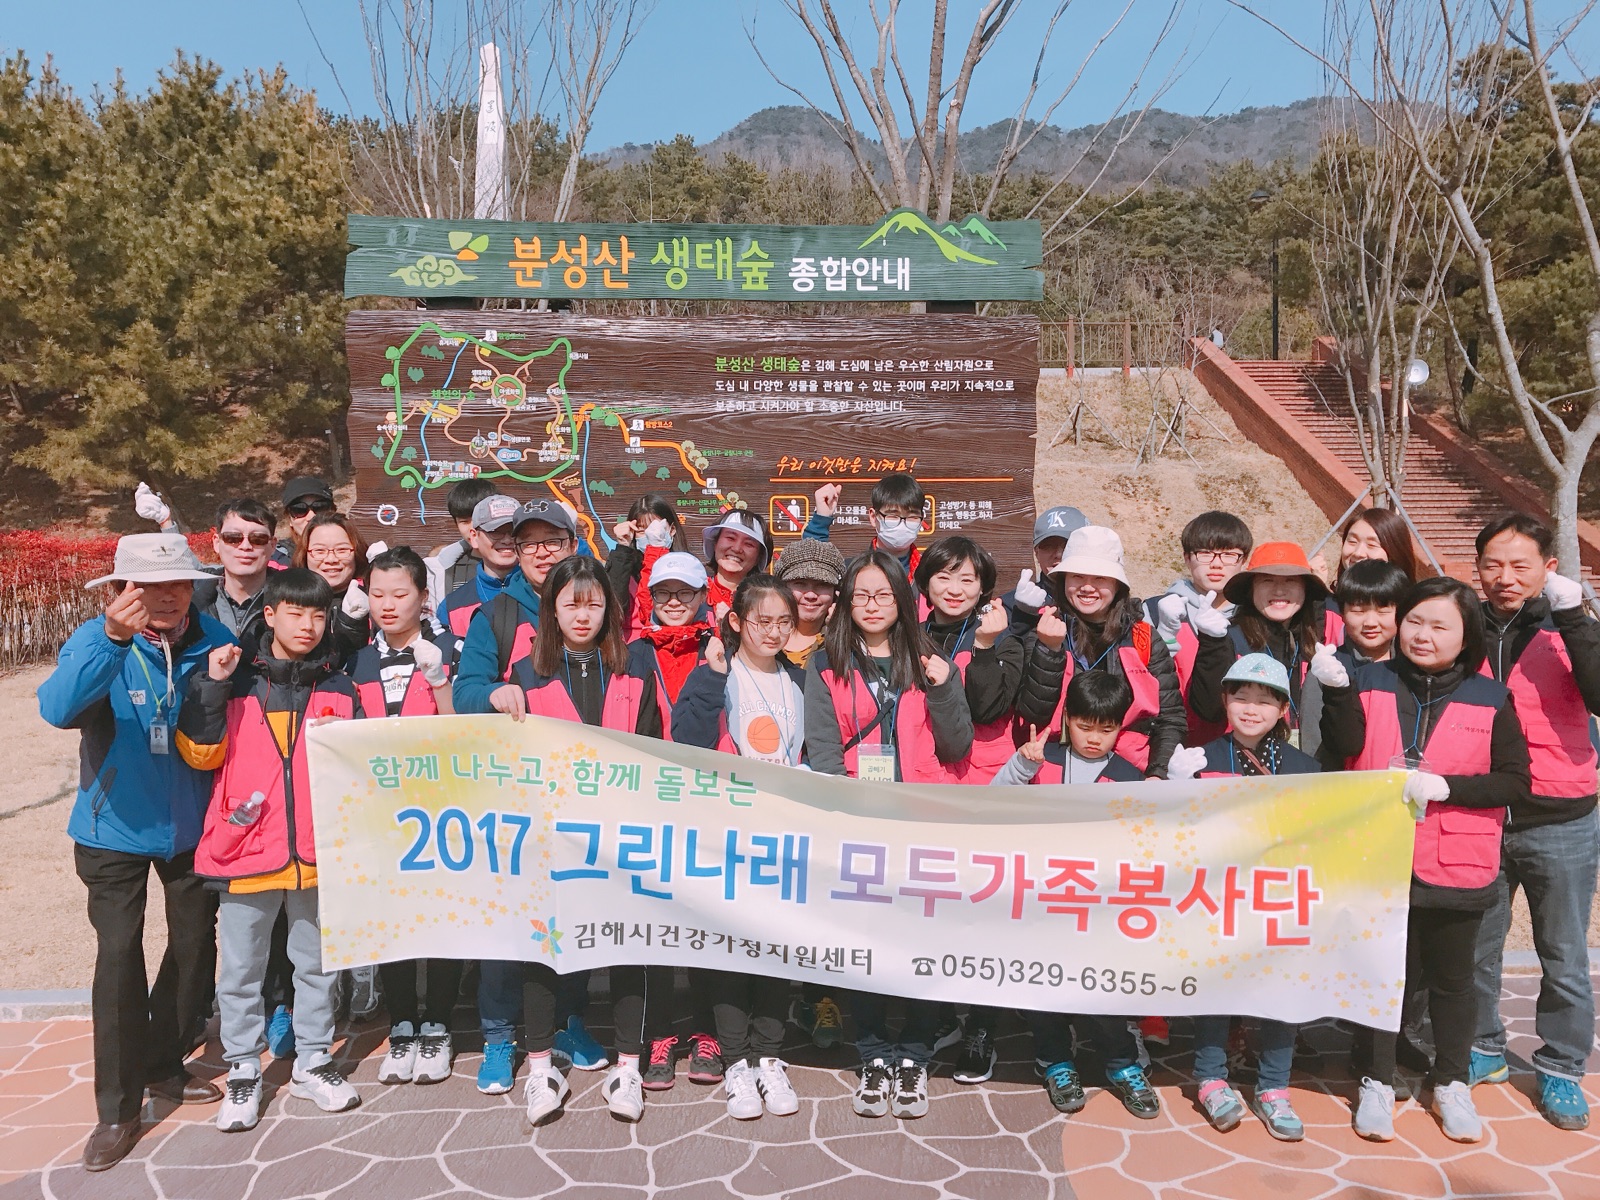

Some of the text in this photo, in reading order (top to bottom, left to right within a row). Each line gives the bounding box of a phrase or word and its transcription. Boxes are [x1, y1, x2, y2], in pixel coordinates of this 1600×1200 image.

[508, 234, 911, 292] 분성산 생태숲 종합안내
[715, 356, 755, 372] 분성산
[815, 360, 835, 372] 김해
[840, 360, 870, 372] 도심에
[874, 360, 894, 372] 남은
[898, 360, 929, 372] 우수한
[933, 360, 994, 372] 산림자원으로
[715, 380, 1015, 392] 도심 내 다양한 생물을 관찰할 수 있는 곳이며 우리가 지속적으로
[431, 389, 476, 400] 체험의 숲
[715, 401, 907, 413] 보존하고 지켜가야 할 소중한 자산입니다.
[776, 456, 918, 476] 우리 이것만은 지켜요!
[845, 506, 867, 516] 오물을
[939, 501, 993, 510] 고성방가 등 피해
[837, 516, 861, 526] 마세요.
[939, 511, 993, 520] 주는 행동은 하지
[939, 520, 962, 530] 마세요.
[368, 753, 759, 808] 함께 나누고, 함께 돌보는
[395, 807, 1321, 949] 2017 그린나래 모두가족봉사단
[572, 921, 874, 978] 김해시건강가정지원센터
